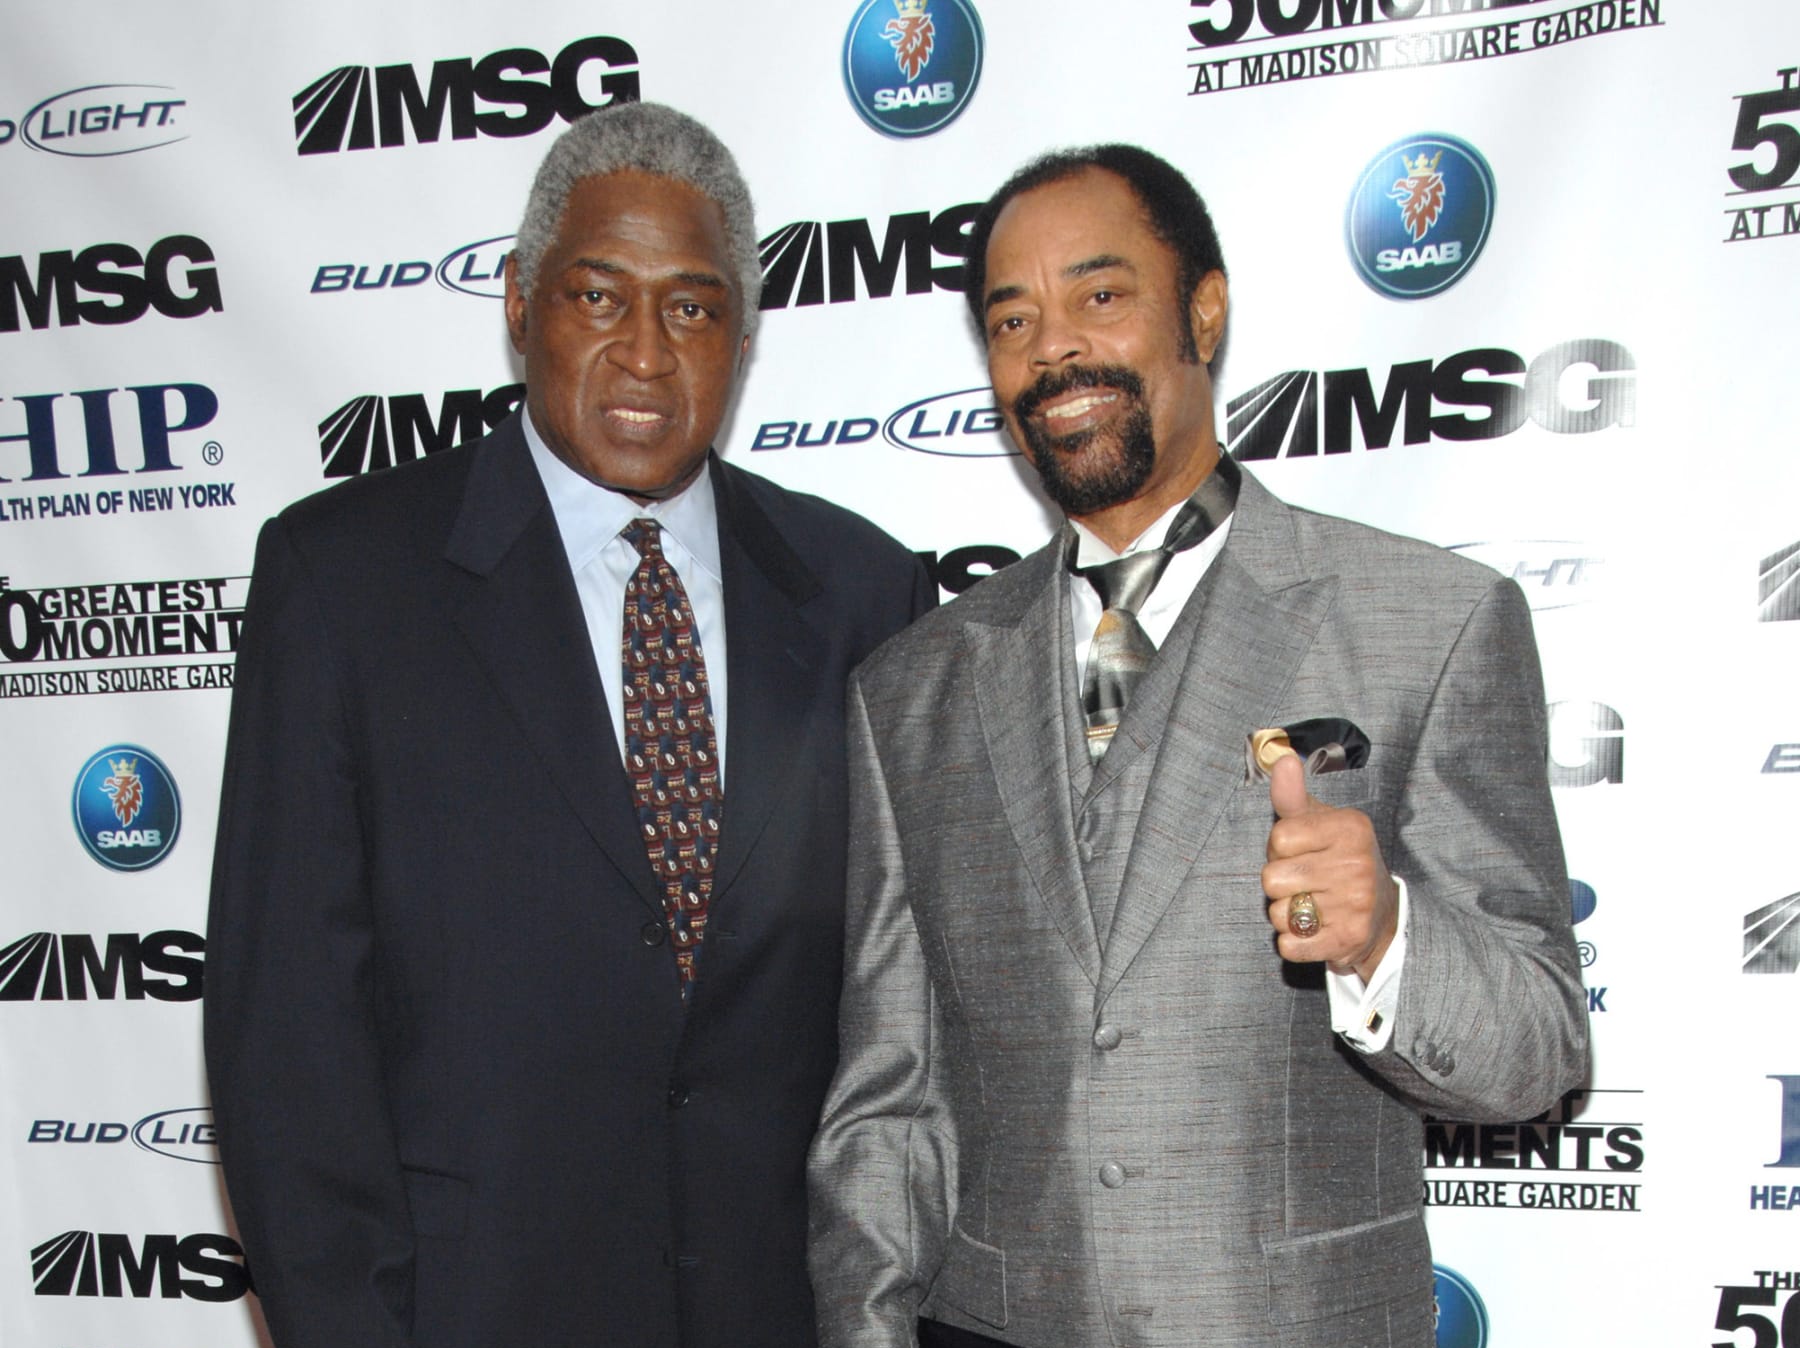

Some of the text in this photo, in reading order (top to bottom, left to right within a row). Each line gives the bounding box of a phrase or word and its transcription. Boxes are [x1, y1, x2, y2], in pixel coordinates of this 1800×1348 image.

[1194, 60, 1230, 93] AT
[1241, 40, 1381, 86] MADISON
[1532, 0, 1660, 48] GARDEN
[375, 36, 641, 147] MSG
[873, 81, 956, 111] SAAB
[40, 100, 186, 140] LIGHT
[1729, 207, 1771, 241] AT
[827, 202, 985, 305] MS
[1375, 241, 1463, 273] SAAB
[0, 235, 224, 332] MSG
[310, 261, 433, 293] BUD
[1324, 338, 1638, 456] MSG
[0, 382, 219, 483] HIP
[750, 407, 1004, 451] BUD LIG
[38, 492, 91, 519] PLAN
[96, 490, 124, 515] OF
[129, 486, 174, 513] NEW
[178, 482, 237, 508] YORK
[37, 578, 228, 620] GREATEST
[42, 611, 246, 661] MOMENT
[97, 666, 179, 693] SQUARE
[187, 664, 236, 688] GAR
[96, 829, 162, 849] SAAB
[61, 929, 207, 1002] MS
[28, 1119, 219, 1146] BUD LIG
[1426, 1125, 1645, 1171] MENTS
[1424, 1181, 1636, 1211] UARE GARDEN
[98, 1232, 256, 1303] MS
